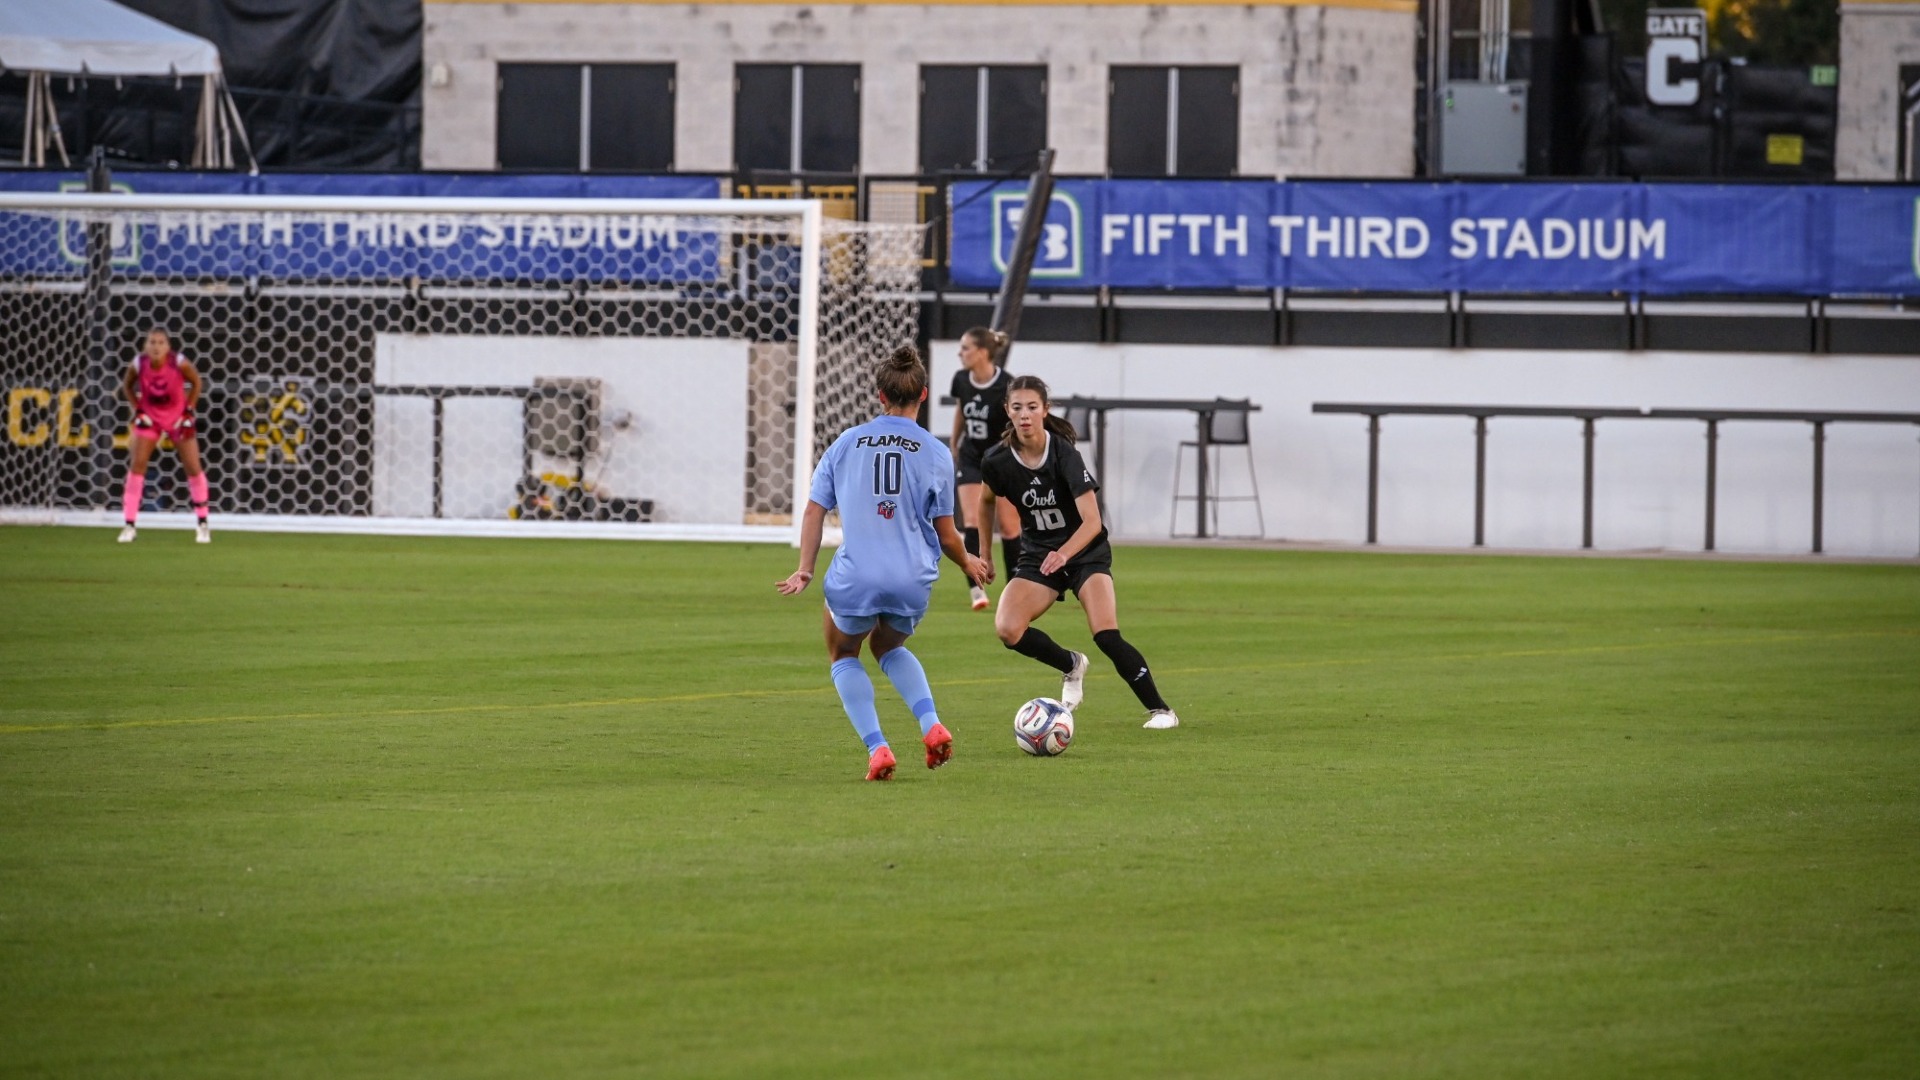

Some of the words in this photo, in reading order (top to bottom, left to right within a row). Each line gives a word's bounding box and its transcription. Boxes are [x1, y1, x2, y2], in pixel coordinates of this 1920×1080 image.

[1646, 16, 1701, 35] GATE
[1646, 38, 1700, 105] C
[159, 207, 293, 246] FIFTH
[314, 208, 458, 248] THIRD
[478, 209, 679, 249] STADIUM
[1102, 214, 1248, 256] FIFTH
[1269, 215, 1430, 258] THIRD
[1450, 217, 1666, 260] STADIUM
[966, 419, 988, 439] 13
[856, 434, 921, 453] FLAMES
[873, 451, 902, 496] 10
[1021, 488, 1057, 508] Owls
[1030, 508, 1066, 531] 10
